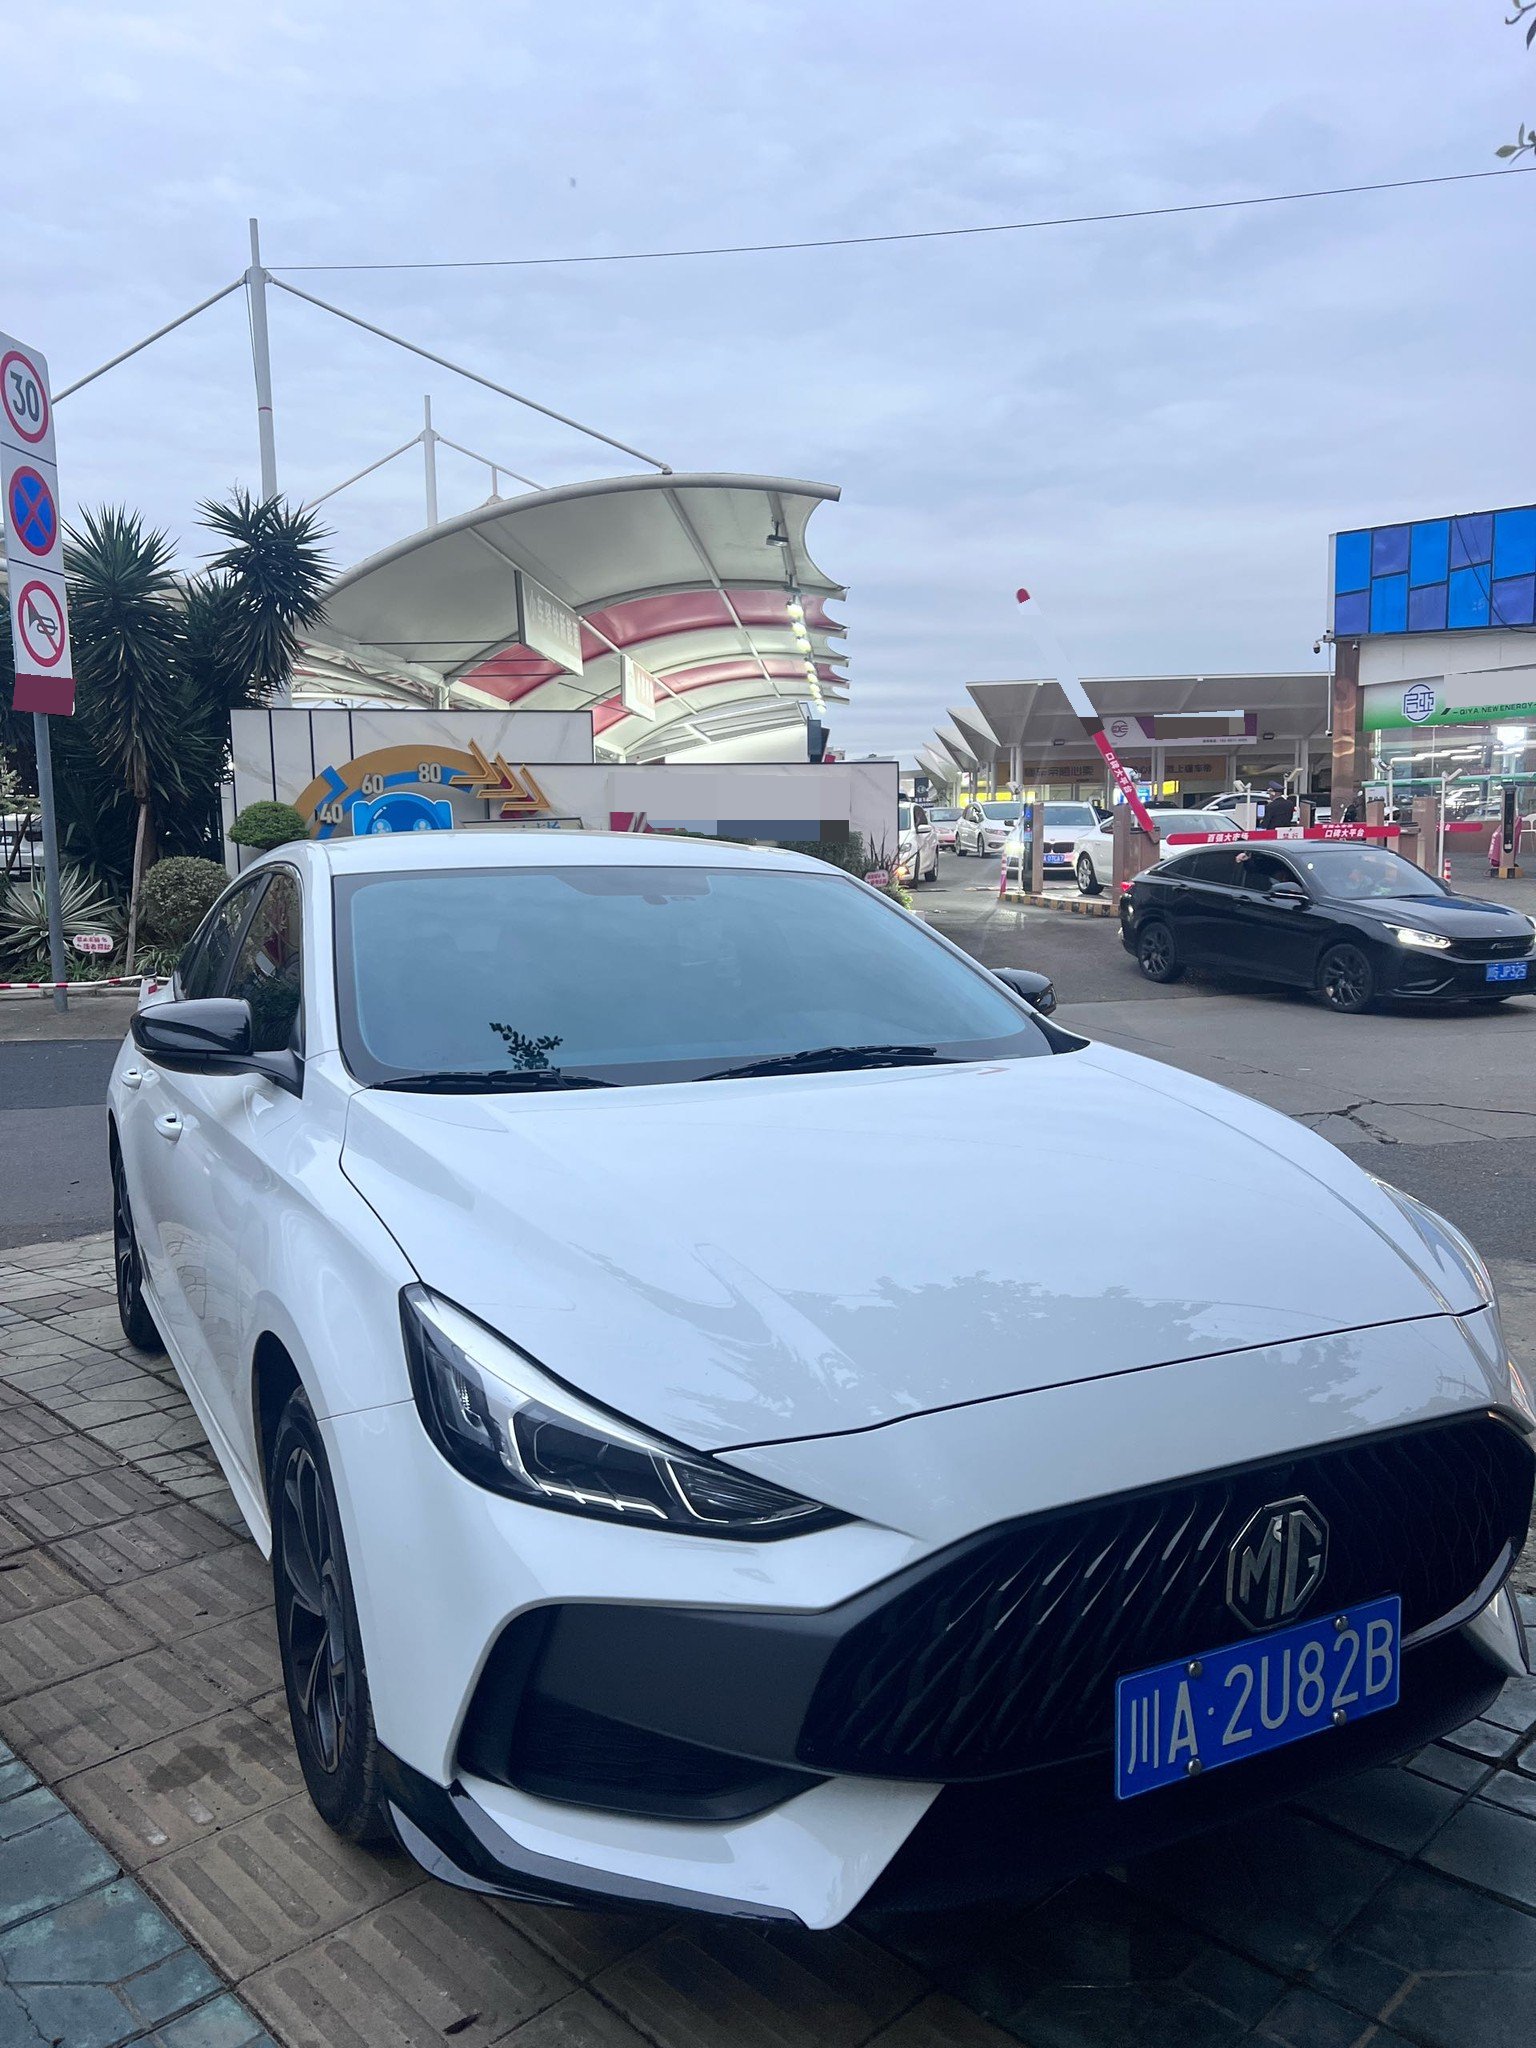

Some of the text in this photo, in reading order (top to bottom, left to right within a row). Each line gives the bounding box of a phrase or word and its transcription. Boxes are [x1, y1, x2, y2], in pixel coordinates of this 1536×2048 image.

[9, 370, 40, 422] 30
[1459, 701, 1534, 716] QIYA NEW ENERGY
[418, 762, 442, 783] 80
[361, 773, 384, 795] 60
[320, 803, 344, 824] 40
[1239, 1509, 1322, 1619] MG
